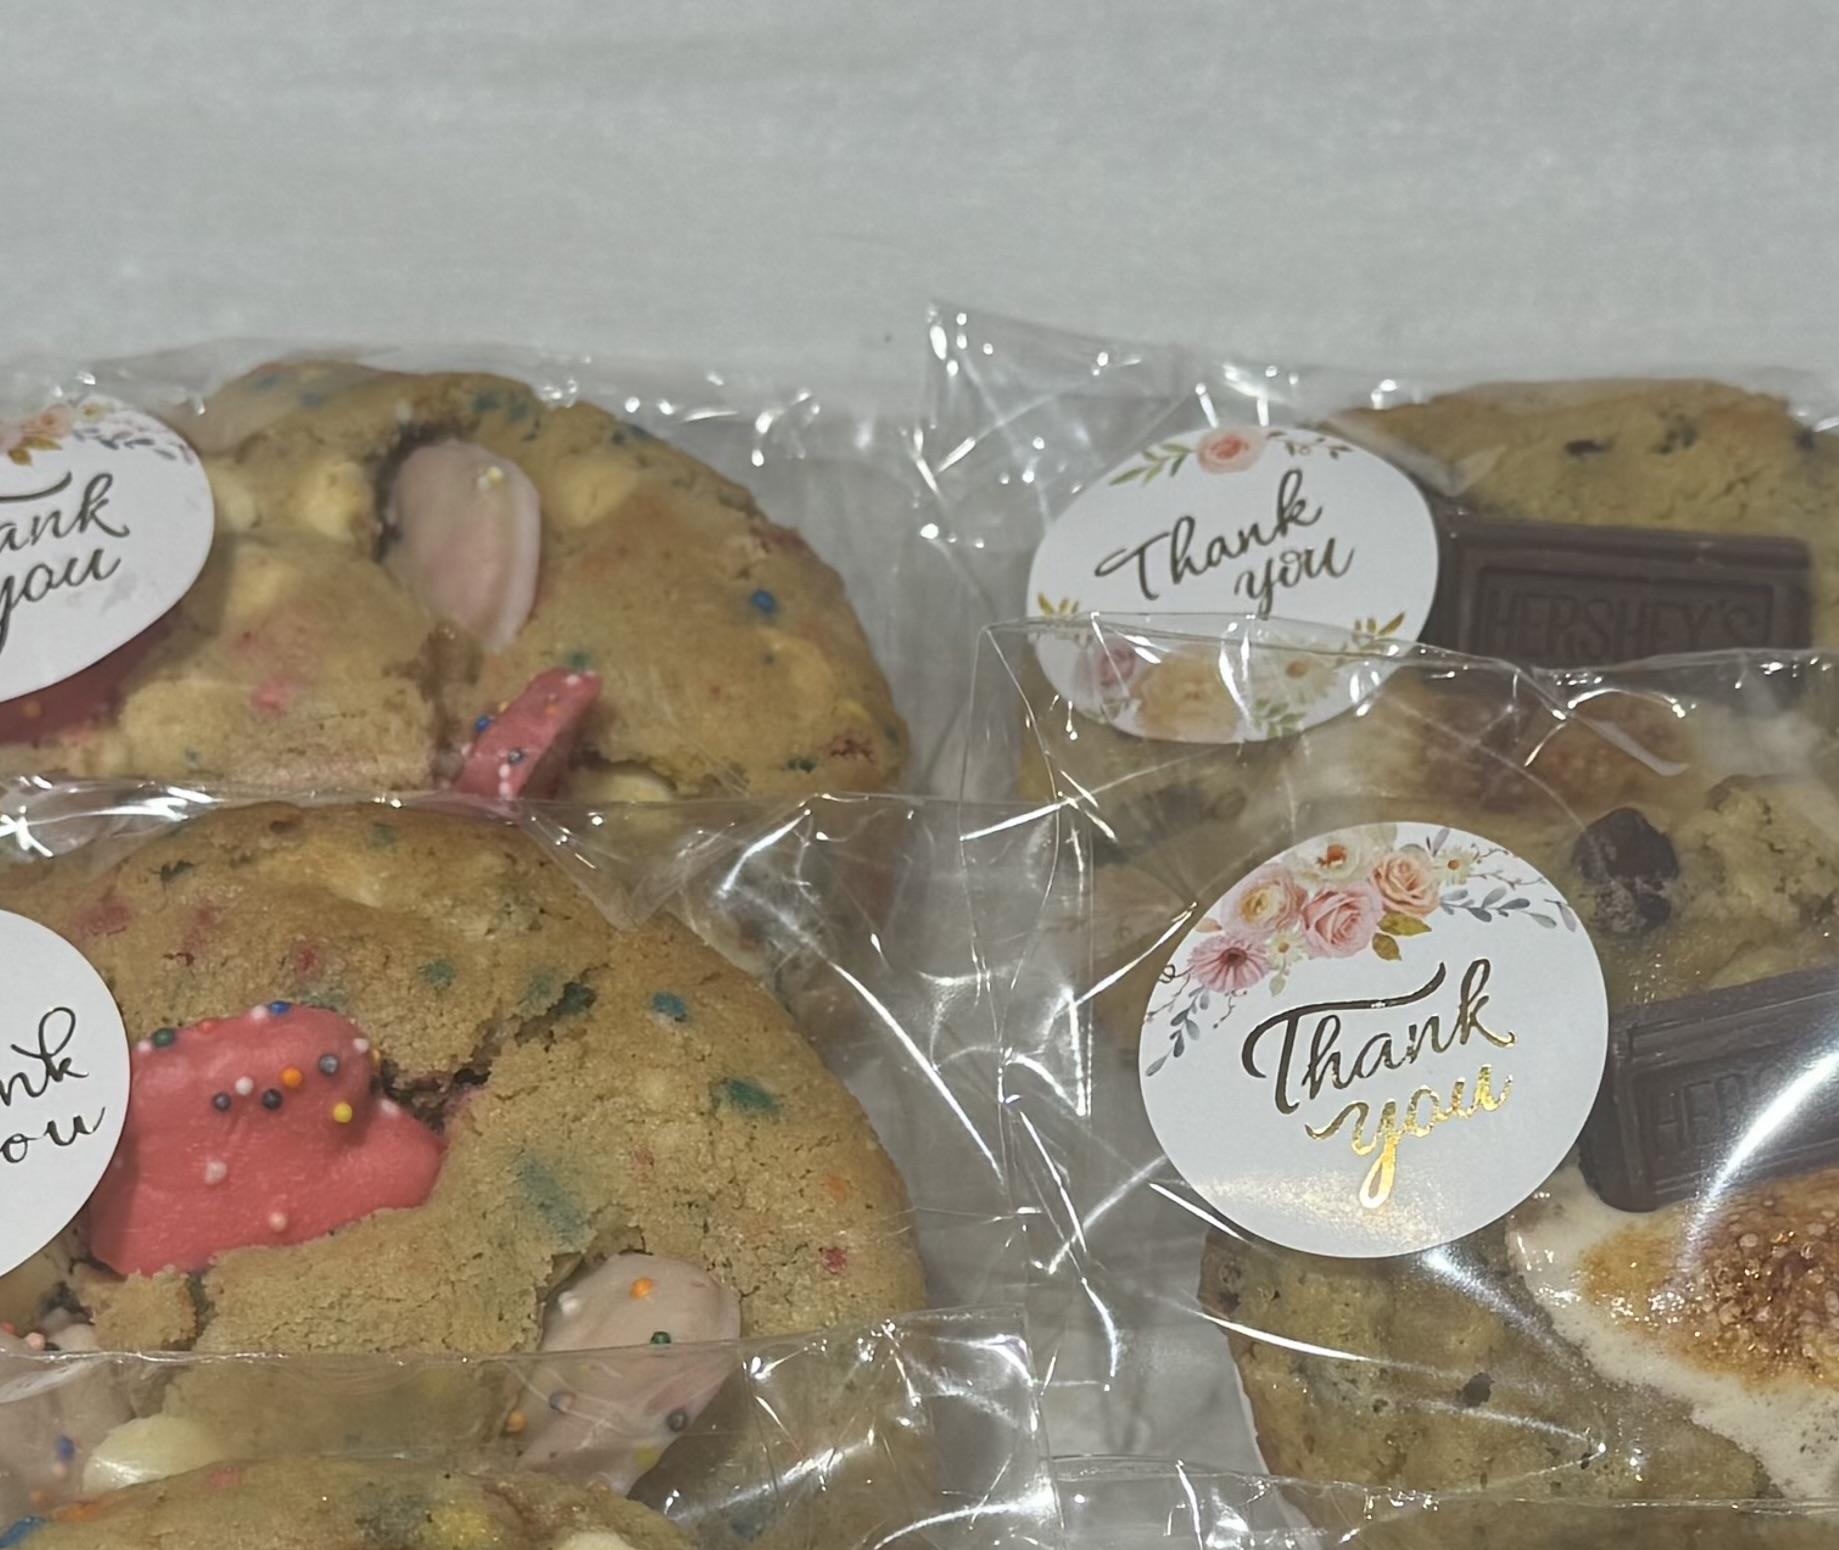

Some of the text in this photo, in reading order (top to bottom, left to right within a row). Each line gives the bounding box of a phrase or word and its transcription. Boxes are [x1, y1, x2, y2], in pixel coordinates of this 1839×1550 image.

[1095, 468, 1322, 600] Thank
[1234, 537, 1355, 620] you
[1241, 958, 1517, 1115] Thank
[1304, 1063, 1514, 1208] you
